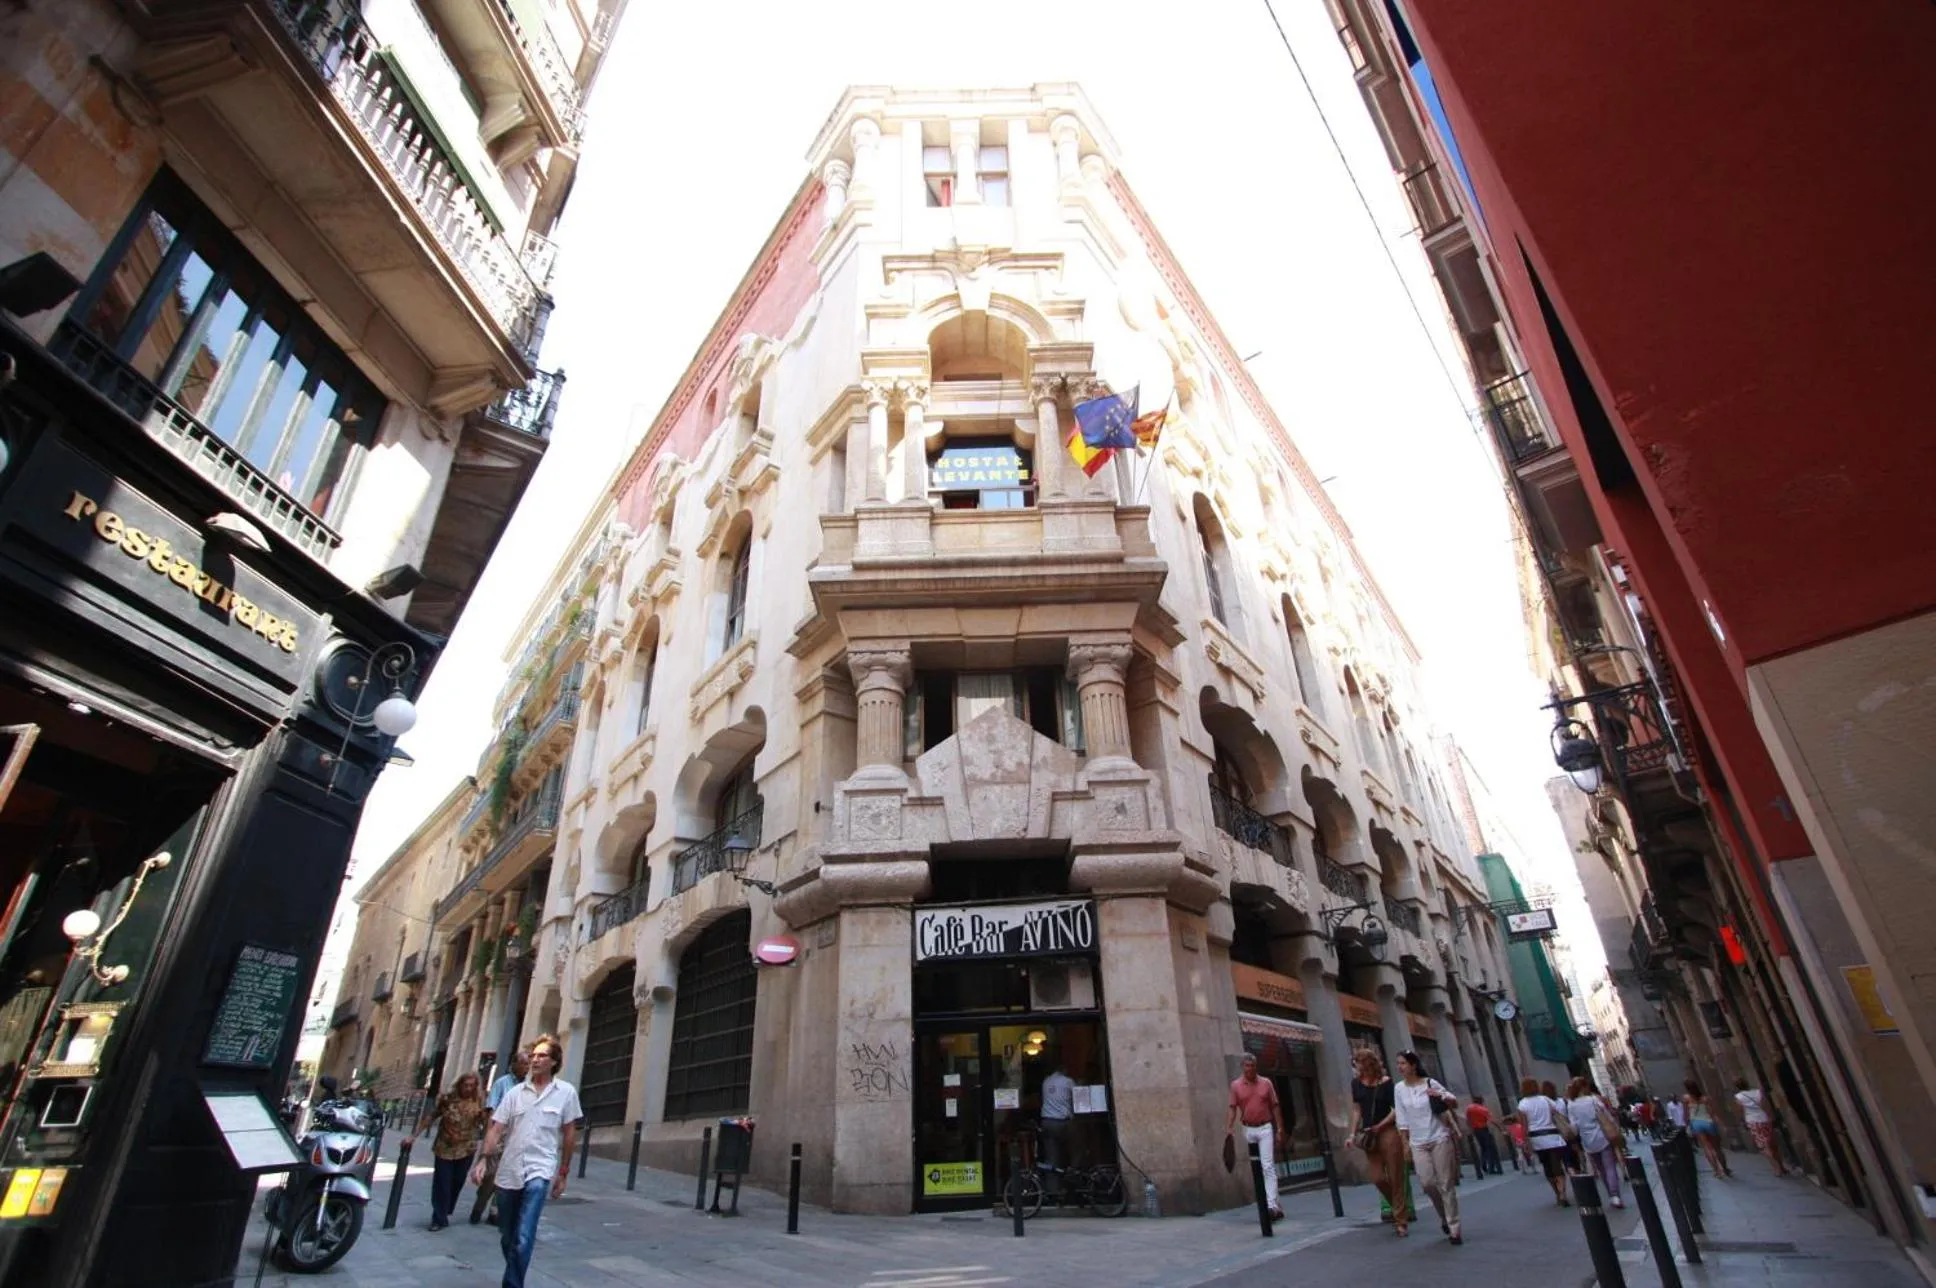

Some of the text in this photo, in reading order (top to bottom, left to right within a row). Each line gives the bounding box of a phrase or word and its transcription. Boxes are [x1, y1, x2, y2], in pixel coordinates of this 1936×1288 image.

[932, 469, 1029, 482] LEVANTE
[937, 456, 1023, 469] HOSTAL
[63, 489, 299, 654] restaurant
[919, 913, 965, 957] Café
[970, 914, 1009, 955] Bar
